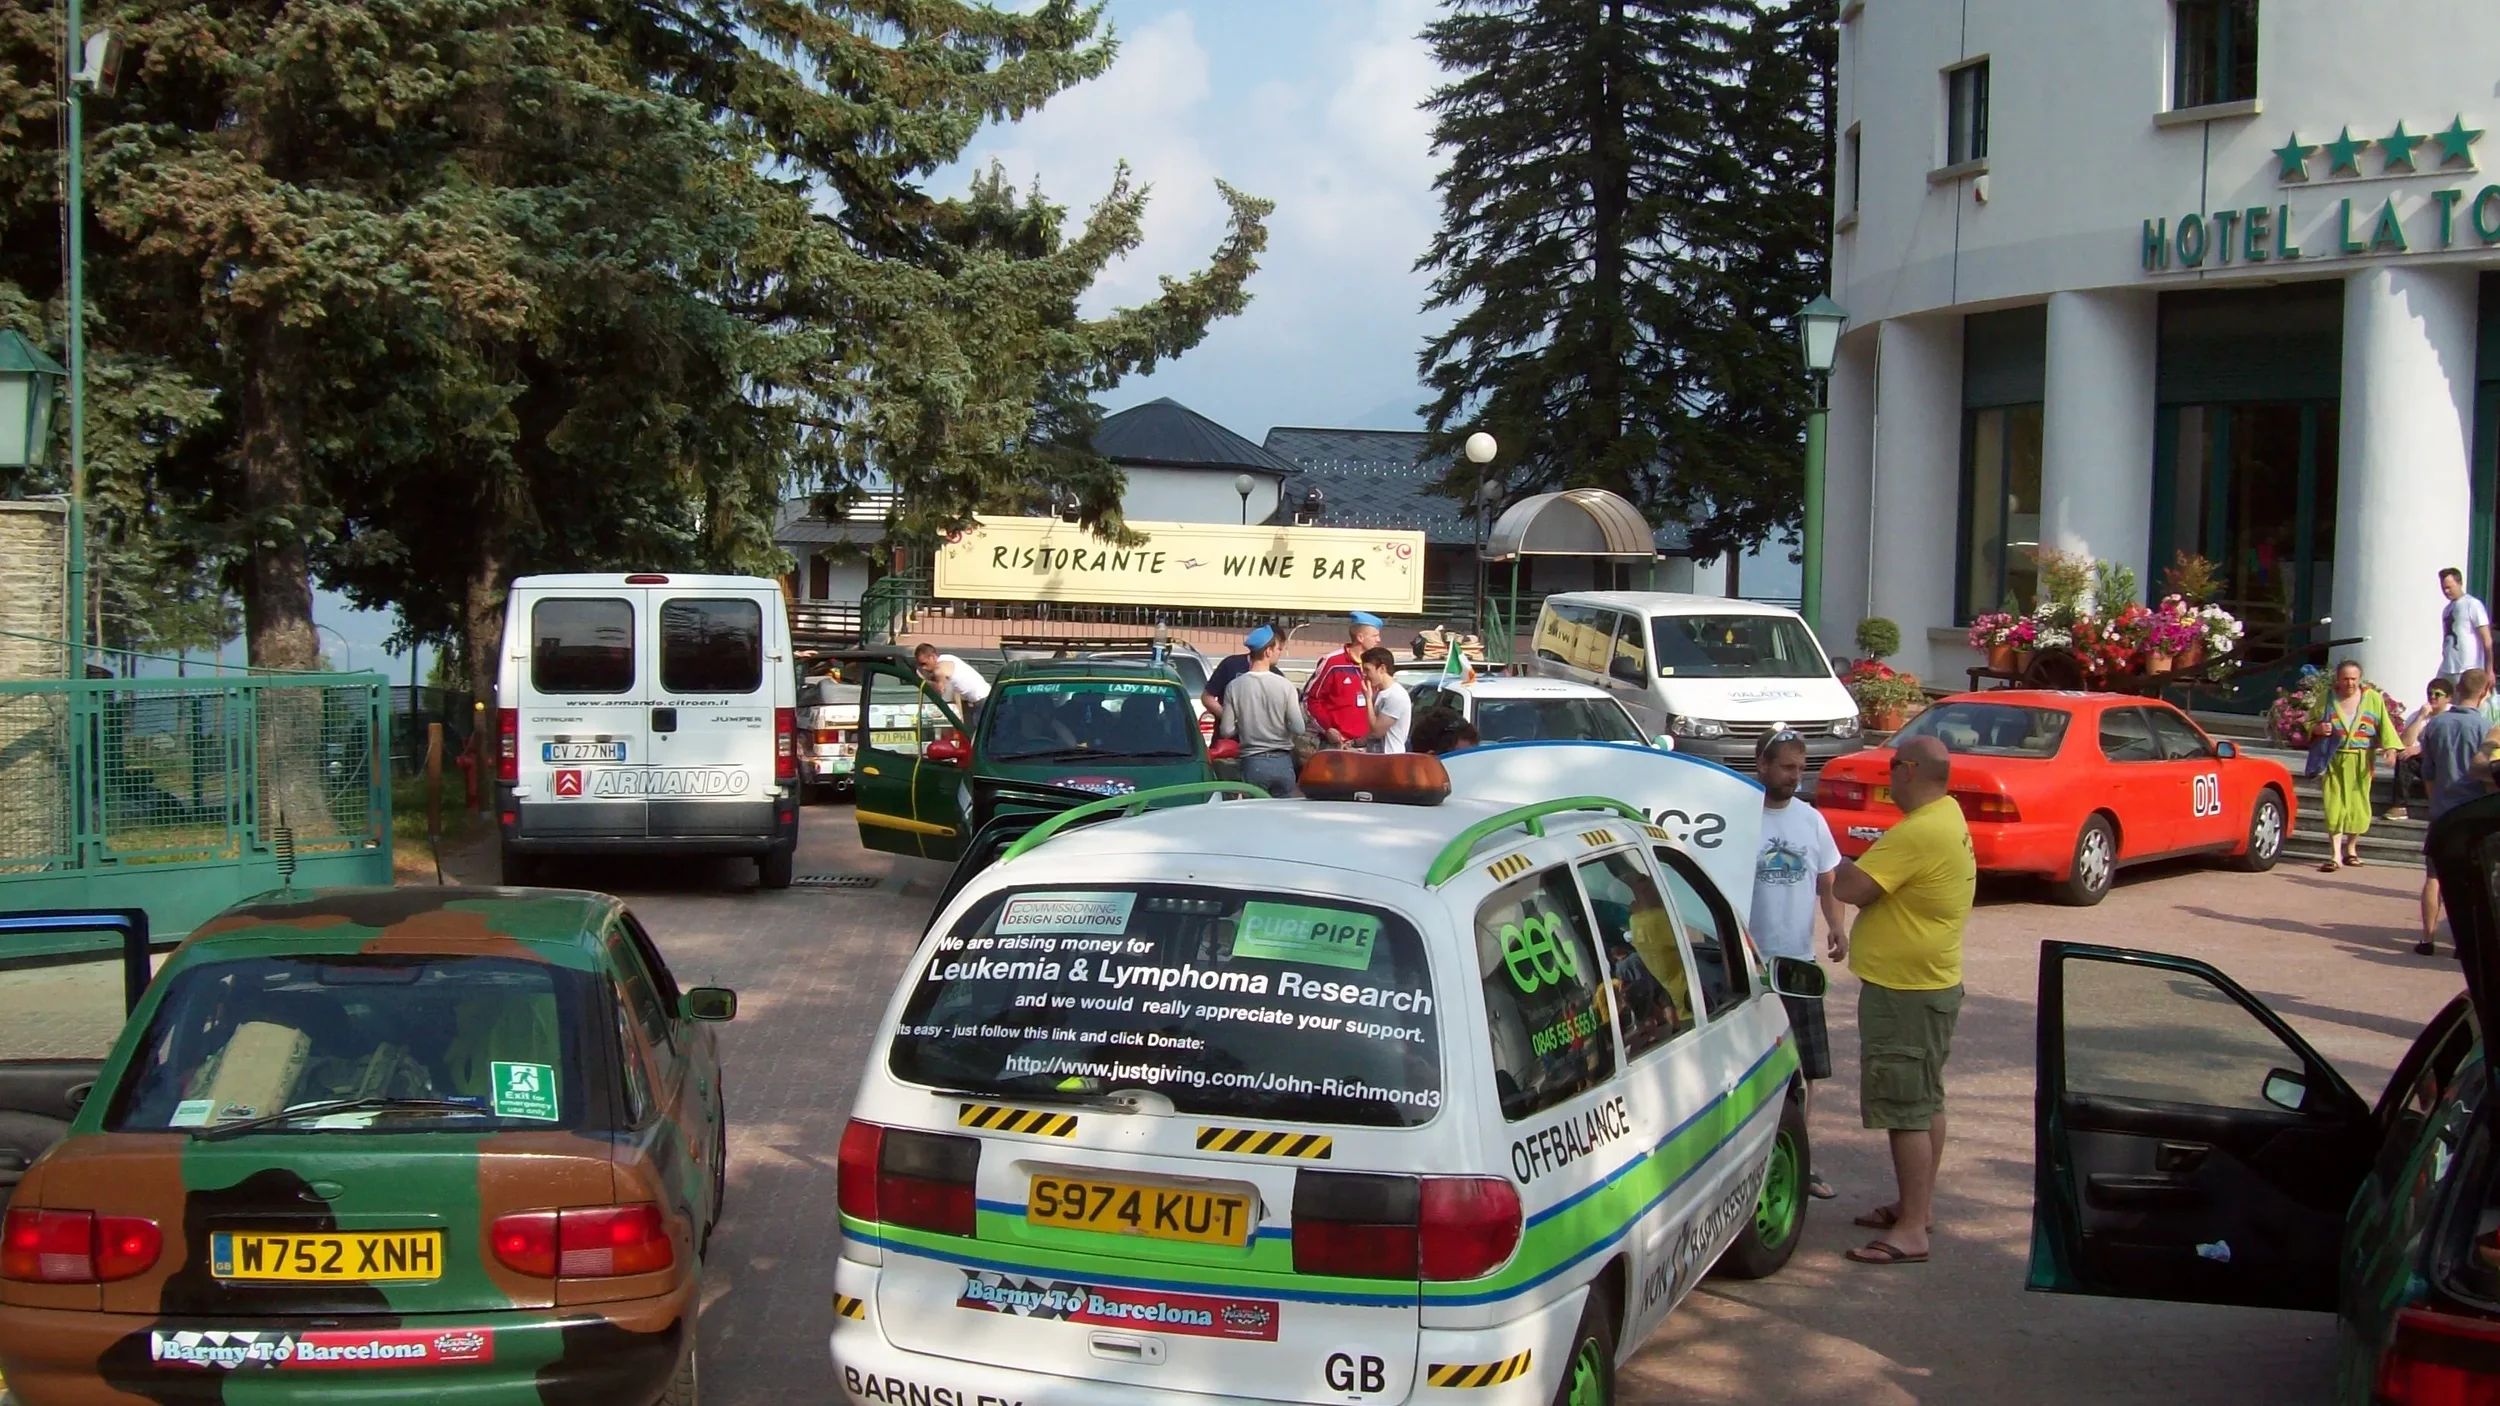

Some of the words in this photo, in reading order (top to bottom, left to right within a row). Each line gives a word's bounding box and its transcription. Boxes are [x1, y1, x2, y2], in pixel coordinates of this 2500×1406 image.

[2141, 203, 2302, 271] HOTEL
[2339, 197, 2409, 254] LA
[992, 545, 1166, 575] RISTORANTE
[1223, 554, 1295, 580] WINE
[1312, 557, 1367, 582] BAR
[1108, 684, 1140, 693] LADY
[566, 699, 729, 707] www.armando.citroen.it
[872, 732, 892, 743] 771
[552, 744, 568, 760] CV
[594, 770, 750, 795] ARMANDO
[2193, 773, 2221, 817] 01
[1008, 914, 1053, 925] DESIGN
[1055, 914, 1122, 926] SOLUTIONS
[1011, 902, 1117, 914] COMMISSIONING
[938, 935, 962, 952] We
[966, 938, 994, 951] are
[997, 935, 1055, 952] raising
[1060, 938, 1122, 955] money
[1126, 938, 1155, 954] for
[928, 956, 1061, 982] Leukemia
[1067, 957, 1089, 983] &
[1098, 958, 1269, 994] Lymphoma
[1277, 971, 1434, 1016] Research
[1014, 992, 1047, 1008] and
[1051, 996, 1076, 1009] we
[1081, 996, 1134, 1012] would
[1142, 999, 1191, 1020] really
[1195, 1005, 1295, 1026] appreciate
[1297, 1013, 1342, 1031] your
[1345, 1019, 1426, 1044] support.
[914, 1025, 942, 1038] easy
[952, 1024, 978, 1039] just
[980, 1024, 1020, 1039] follow
[1023, 1026, 1049, 1040] this
[1052, 1027, 1078, 1042] link
[1079, 1029, 1108, 1044] and
[1110, 1031, 1144, 1046] click
[1147, 1033, 1205, 1051] Donate:
[1532, 1029, 1558, 1057] 0845
[1006, 1054, 1441, 1108] http://www.justgiving.com/John-Richmond3
[500, 1099, 552, 1110] emergency
[505, 1090, 530, 1100] Exit
[526, 1108, 547, 1117] only
[1511, 1095, 1631, 1185] OFFBALANCE
[1034, 1180, 1142, 1227] S974
[1154, 1192, 1243, 1237] KUT
[215, 1263, 232, 1271] GB
[241, 1237, 344, 1274] W752
[357, 1237, 434, 1273] XNH
[966, 1278, 1044, 1312] Barmy
[1050, 1290, 1083, 1312] To
[1087, 1294, 1213, 1326] Barcelona
[162, 1340, 248, 1363] Barmy
[254, 1342, 291, 1361] To
[296, 1340, 427, 1362] Barcelona
[845, 1365, 1023, 1406] BARNS
[1325, 1352, 1386, 1393] GB
